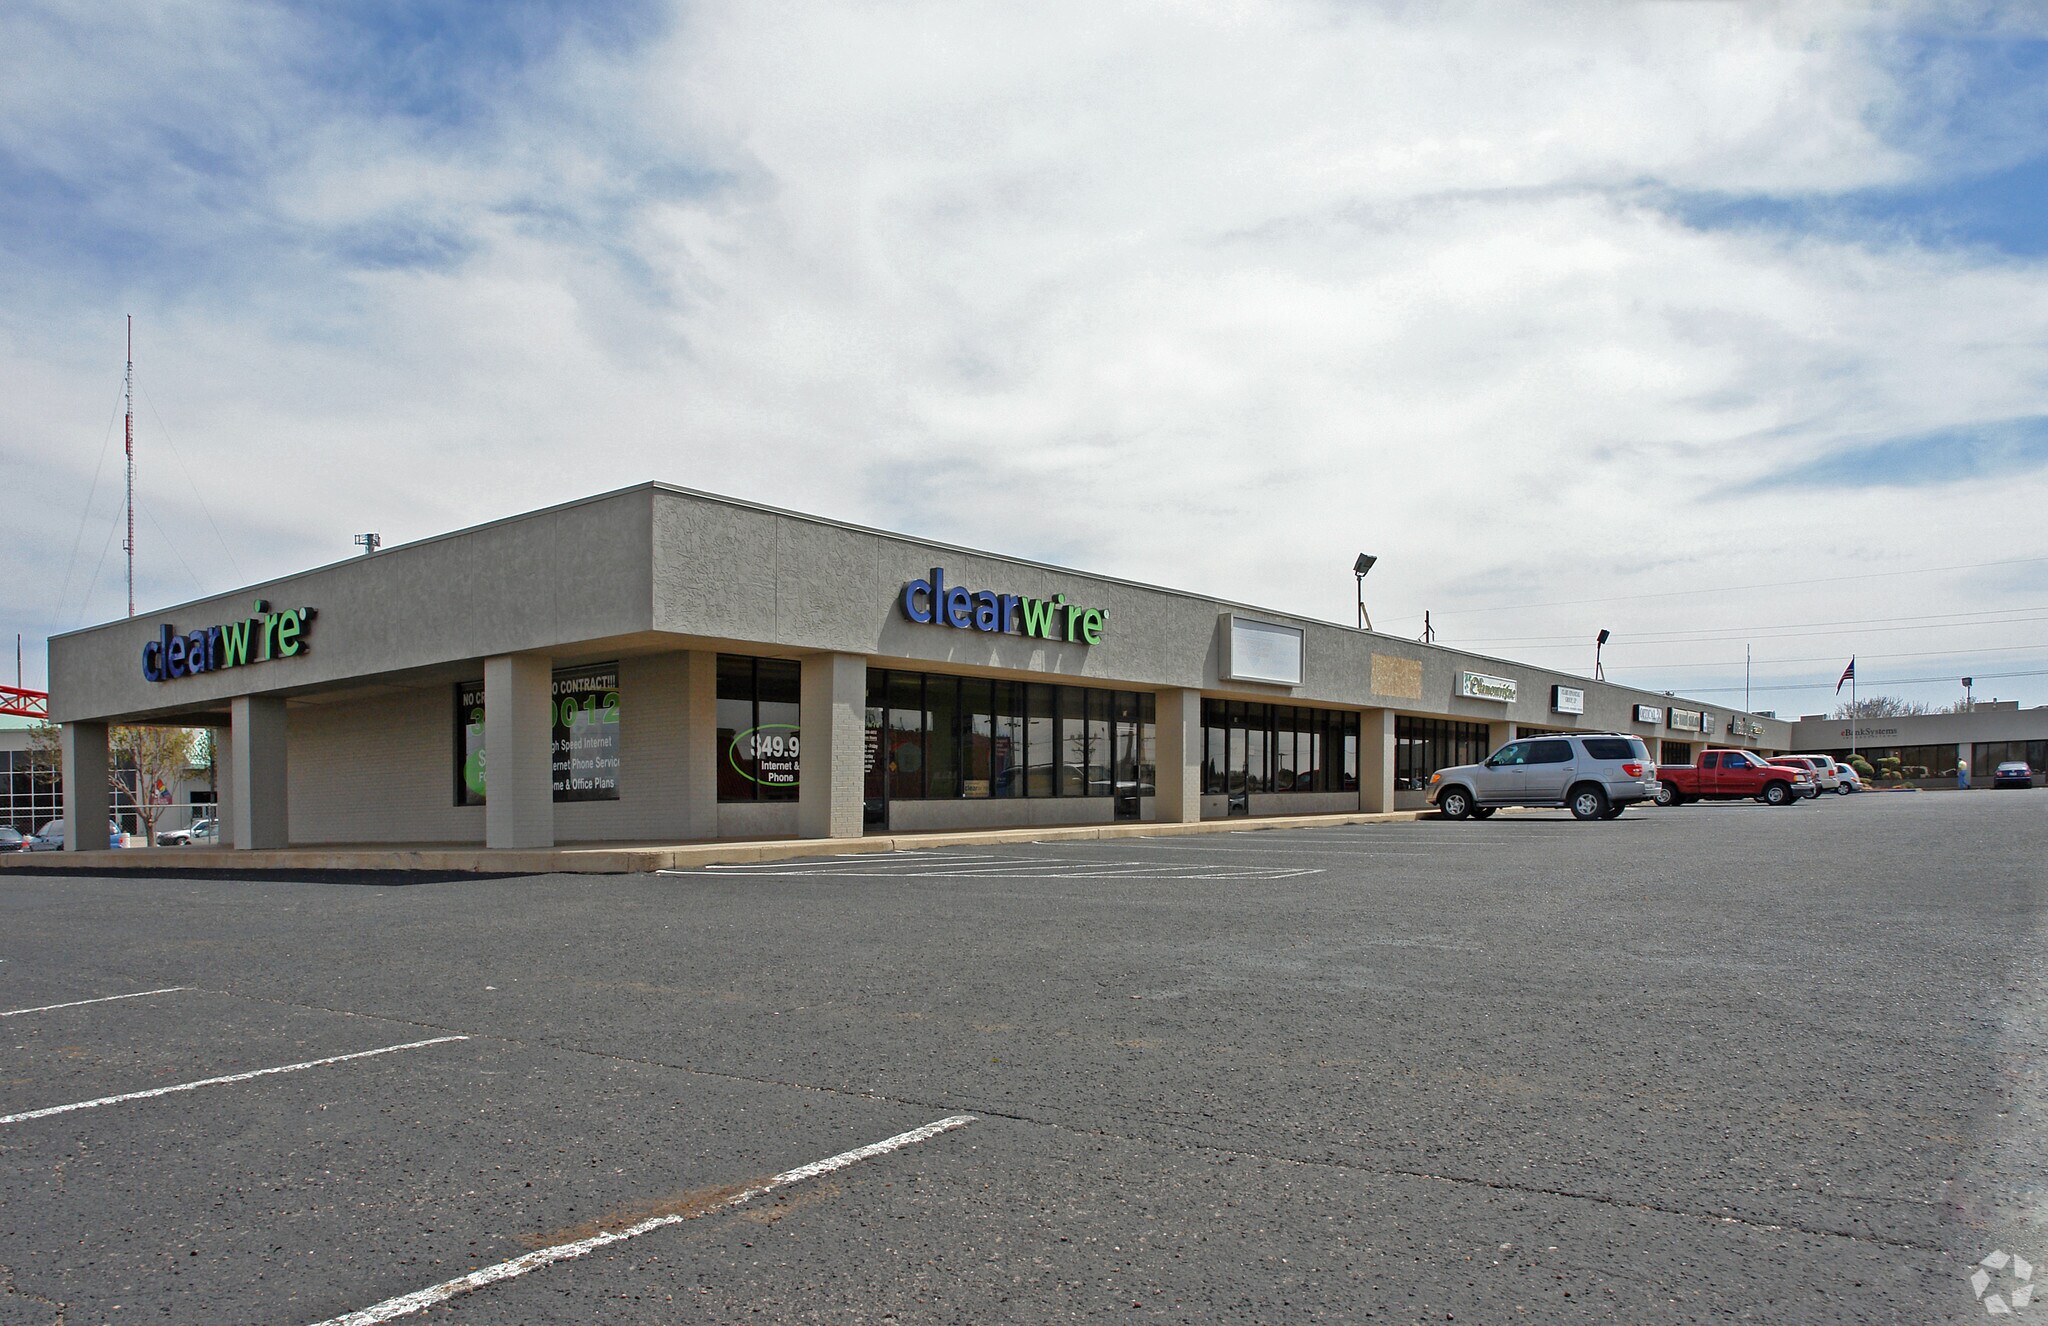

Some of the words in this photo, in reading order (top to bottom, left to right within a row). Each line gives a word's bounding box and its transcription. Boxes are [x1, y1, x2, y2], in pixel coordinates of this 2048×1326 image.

[561, 675, 616, 694] CONTRACT!!!
[561, 738, 583, 752] Speed
[584, 736, 612, 748] Internet
[572, 758, 594, 769] Phone
[761, 760, 792, 771] Internet
[793, 760, 800, 770] &
[565, 778, 571, 790] &
[572, 778, 593, 790] Office
[594, 776, 615, 789] Plans
[768, 772, 794, 782] Phone
